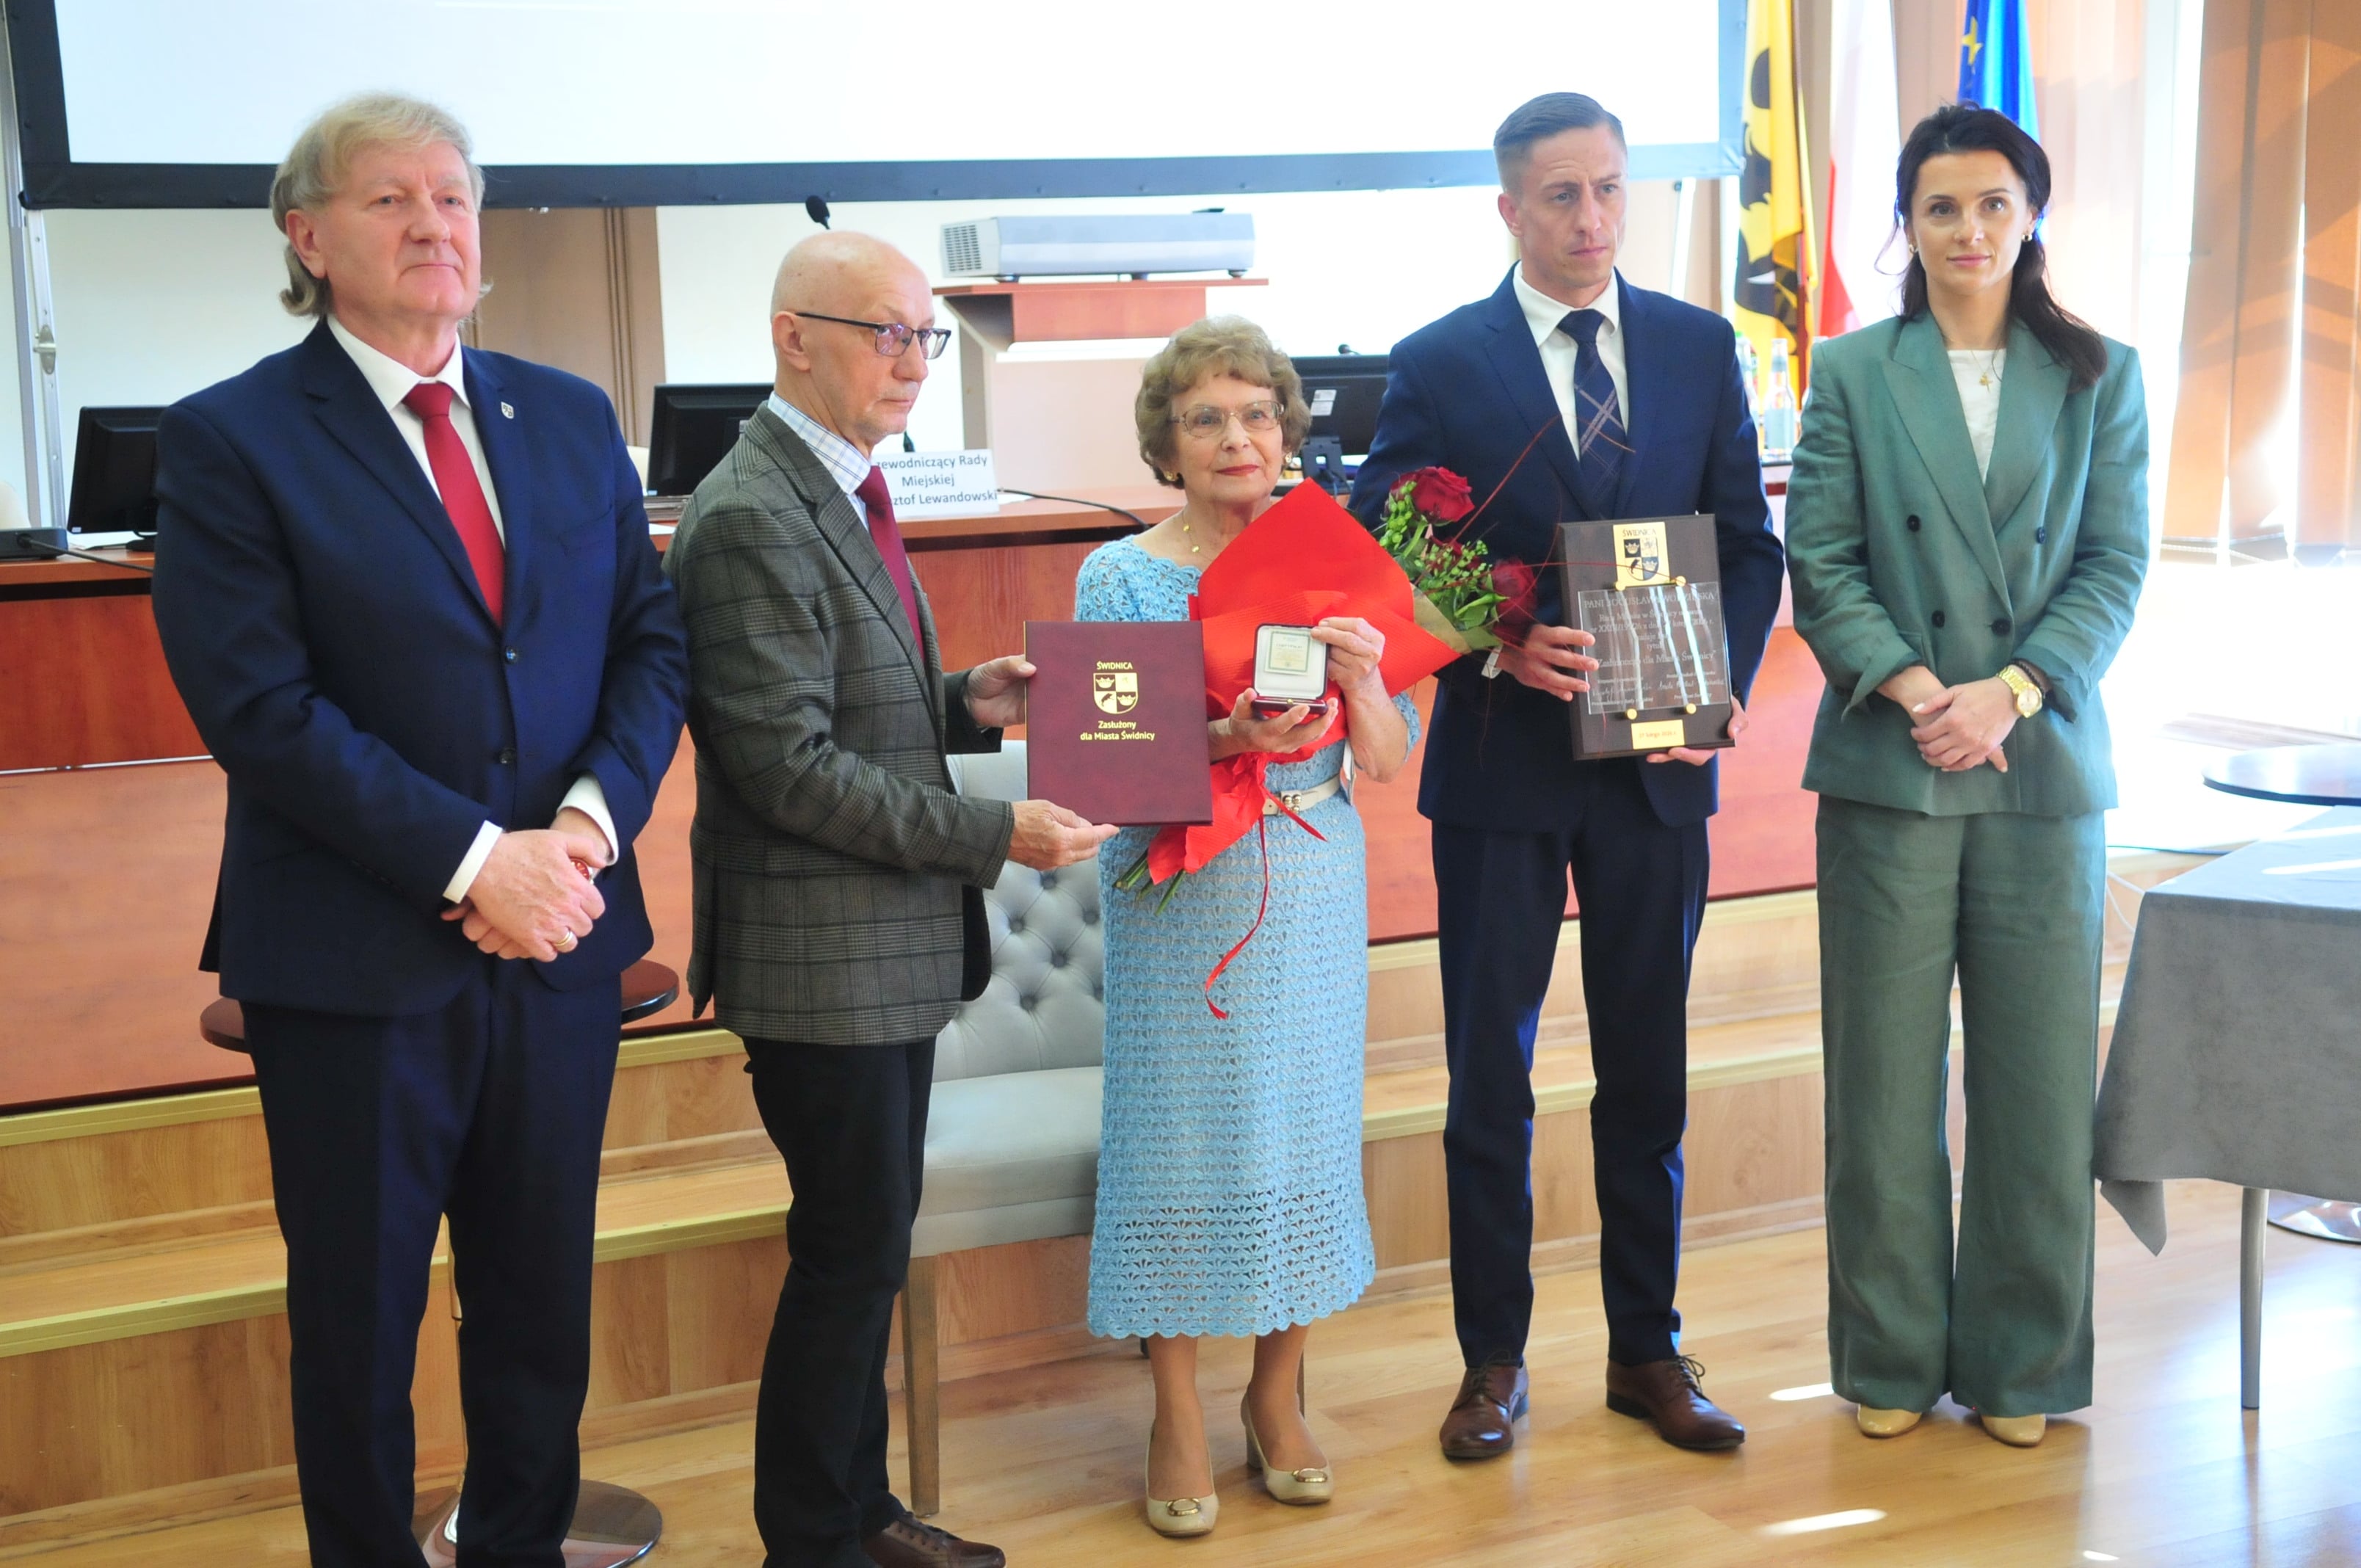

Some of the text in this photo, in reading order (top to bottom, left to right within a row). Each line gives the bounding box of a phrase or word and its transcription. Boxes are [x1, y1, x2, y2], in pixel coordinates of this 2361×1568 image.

[877, 454, 987, 470] zewodniczący Rady
[902, 473, 955, 488] Miejskiej
[919, 490, 998, 505] Lewandowski
[1096, 661, 1133, 669] ŚWIDNICA
[1098, 720, 1136, 730] Zasłużony
[1080, 730, 1156, 741] dla Miasta Świdnicy
